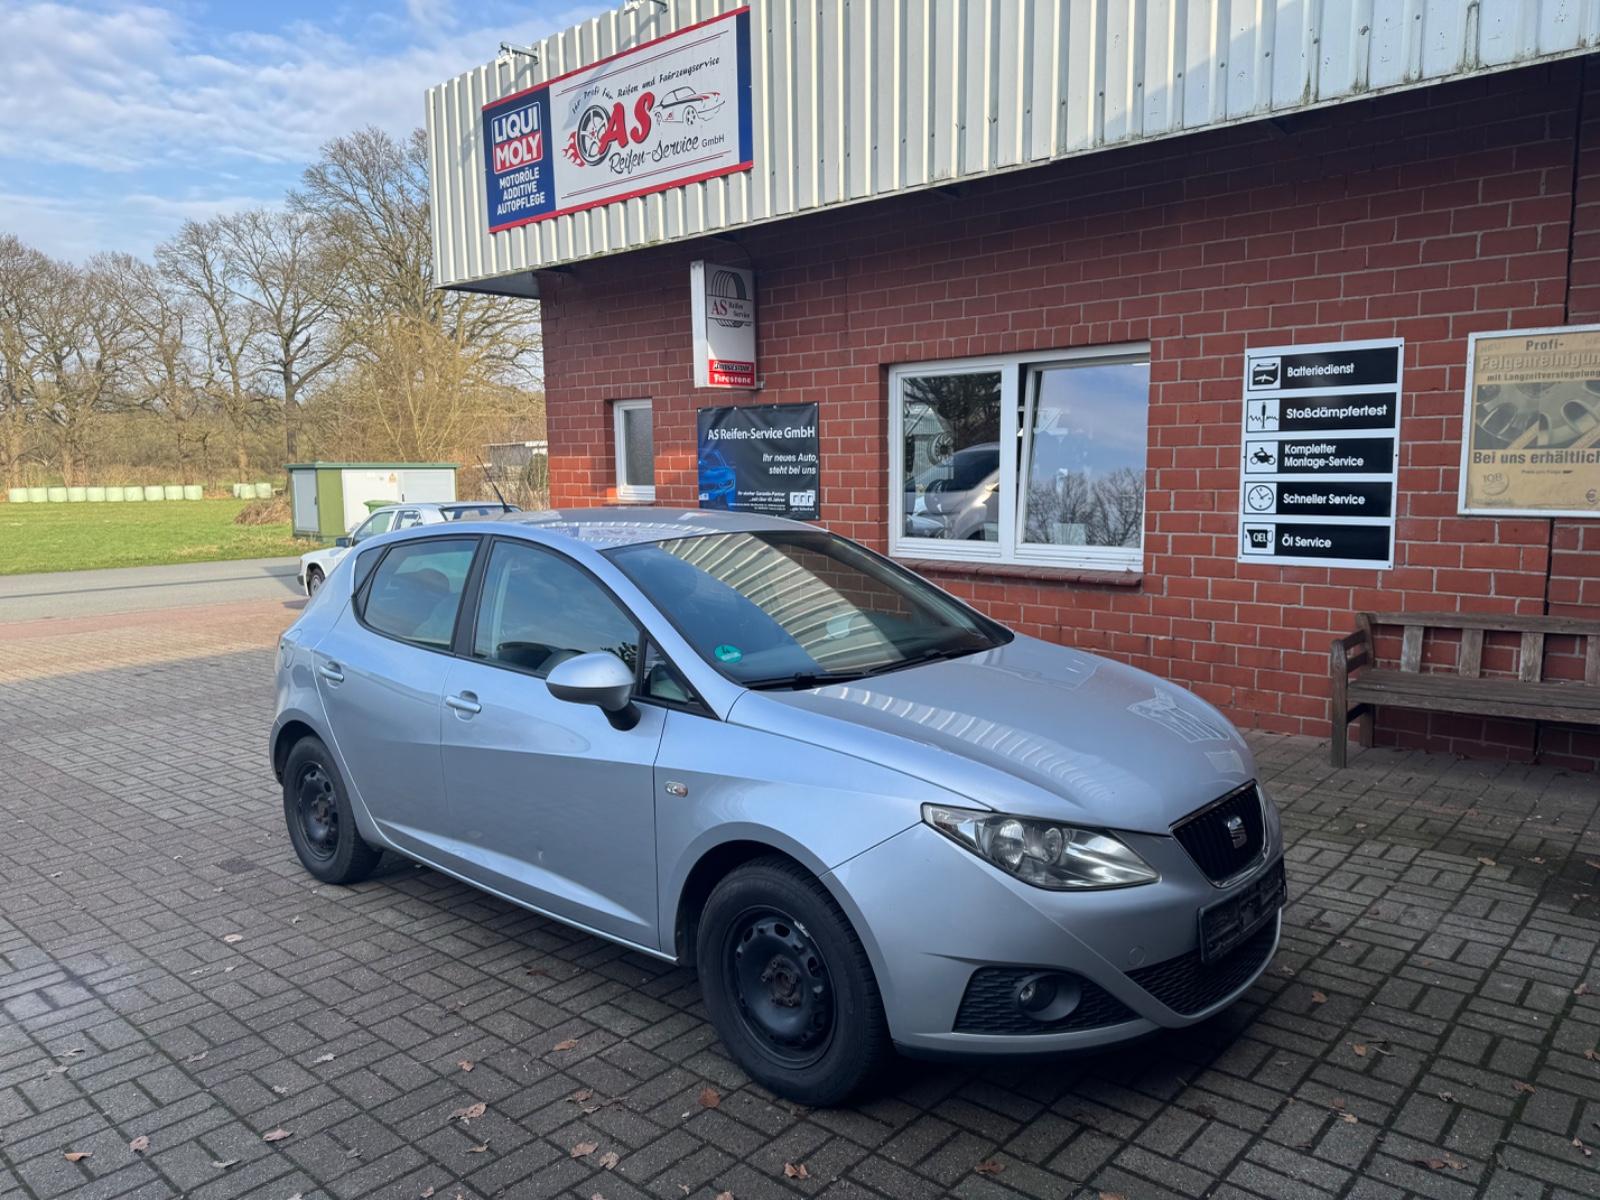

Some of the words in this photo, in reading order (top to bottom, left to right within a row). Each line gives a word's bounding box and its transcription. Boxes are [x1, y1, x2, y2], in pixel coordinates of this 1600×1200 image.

[617, 84, 638, 98] Reifen
[641, 76, 656, 88] und
[659, 56, 720, 84] Fahrzeugservice
[494, 106, 539, 144] LIQUI
[598, 91, 655, 156] AS
[495, 133, 541, 171] MOLY
[608, 135, 700, 175] Reifen-Service
[701, 133, 725, 149] GmbH
[499, 167, 540, 189] MOTORÖLE
[502, 181, 538, 201] ADDITIVE
[497, 192, 546, 216] AUTOPFLEGE
[711, 299, 728, 317] AS
[1525, 340, 1564, 351] Profi-
[1287, 362, 1355, 378] Batteriedienst
[1286, 404, 1388, 421] Stoßdämpfertest
[708, 429, 719, 440] AS
[721, 427, 783, 440] Reifen-Service
[783, 426, 815, 439] GmbH
[762, 453, 772, 463] Ihr
[773, 454, 796, 462] neues
[1284, 443, 1337, 457] Kompletter
[1473, 452, 1496, 464] Bei
[1500, 454, 1526, 464] uns
[1284, 455, 1364, 468] Montage-Service
[769, 465, 787, 475] steht
[788, 465, 801, 475] bei
[1283, 493, 1326, 506] Schneller
[1326, 493, 1366, 506] Service
[1253, 532, 1267, 542] OEL
[1282, 533, 1293, 547] Öl
[1294, 537, 1332, 549] Service
